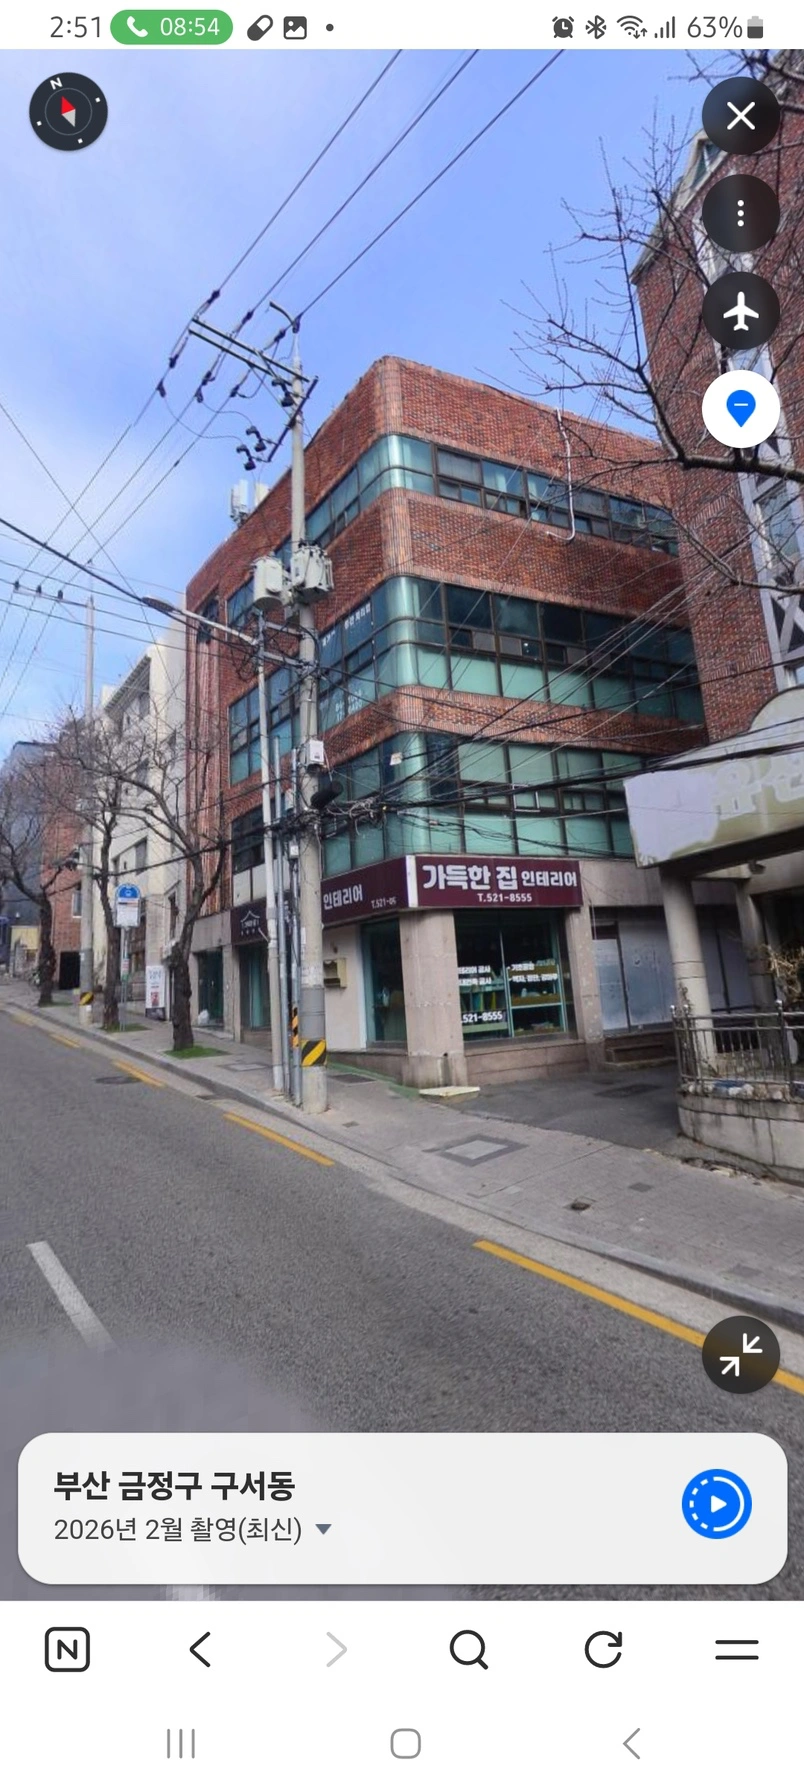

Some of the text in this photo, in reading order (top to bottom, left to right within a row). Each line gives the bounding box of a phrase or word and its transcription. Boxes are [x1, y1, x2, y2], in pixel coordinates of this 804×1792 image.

[422, 865, 577, 891] 가득한 집 인테리어
[323, 884, 363, 910] 인테리어
[477, 892, 533, 903] T.521-8555
